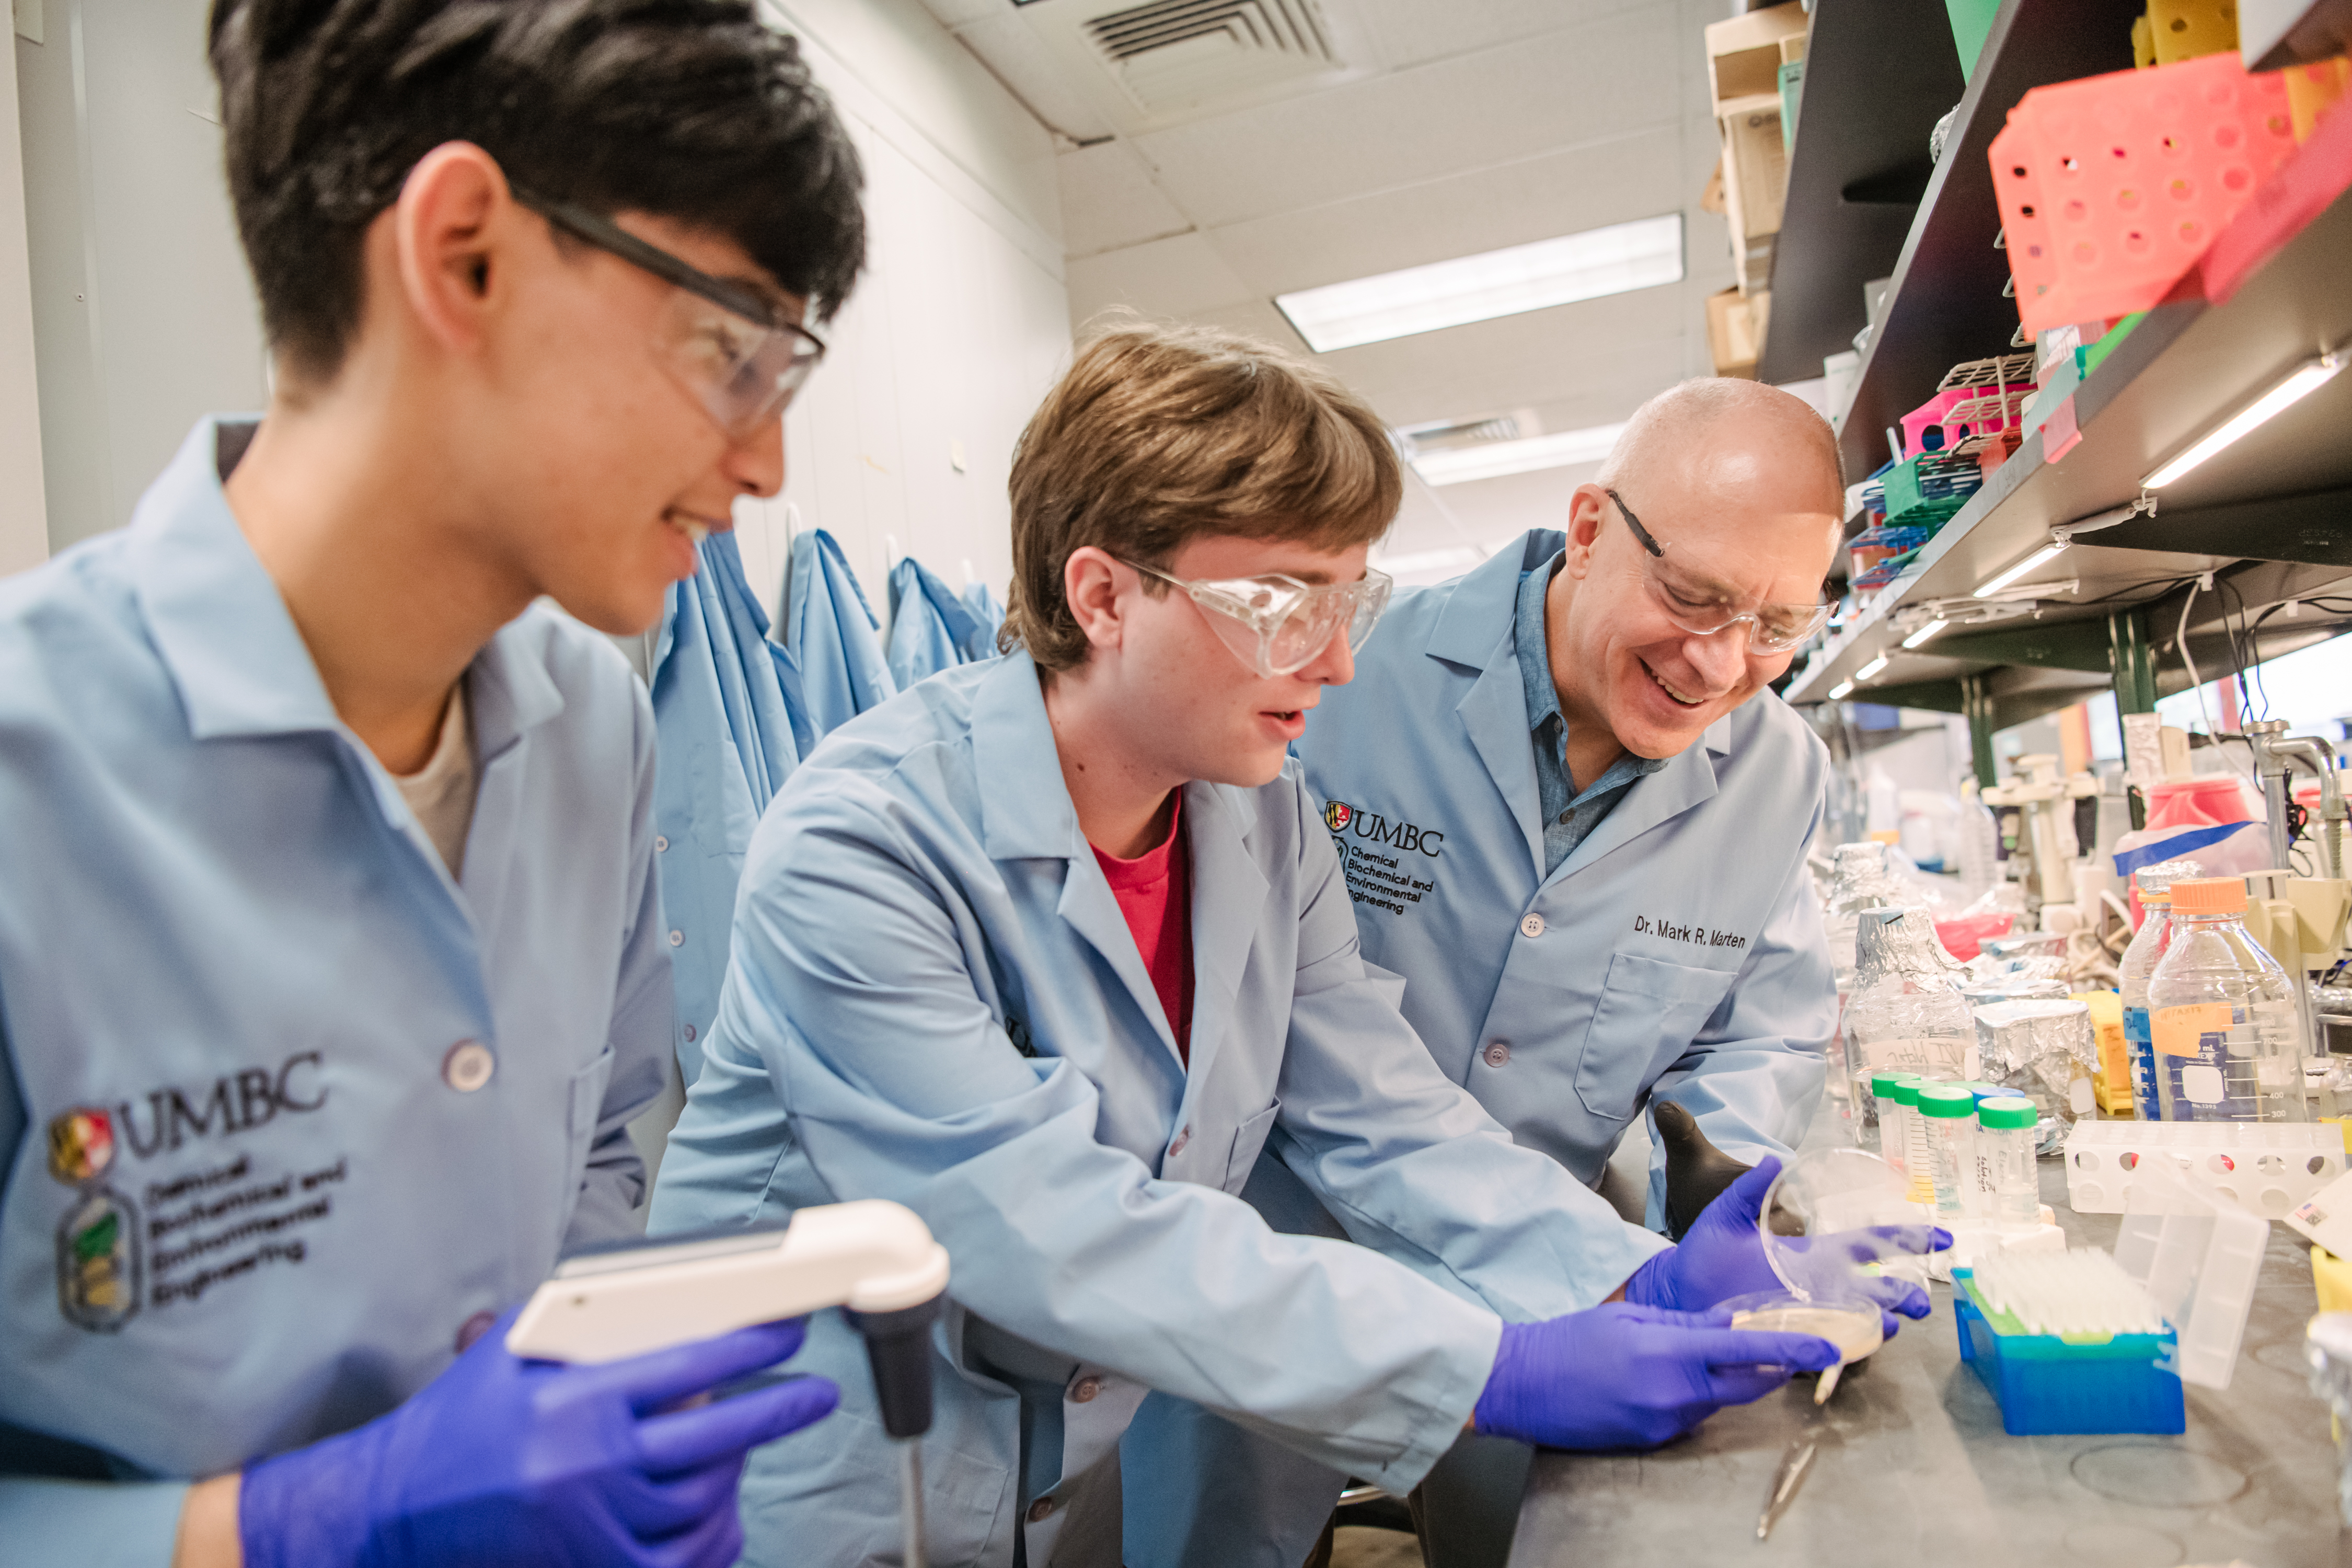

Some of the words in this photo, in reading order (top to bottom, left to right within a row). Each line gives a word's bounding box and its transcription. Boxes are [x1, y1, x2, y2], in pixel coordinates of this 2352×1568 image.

[1355, 810, 1444, 857] UMBC
[1351, 846, 1399, 869] Chemical
[1346, 871, 1422, 903] Environmental
[1348, 858, 1411, 885] Biochemical
[1412, 881, 1434, 892] and
[1634, 915, 1653, 935] Dr.
[1658, 919, 1691, 942] Mark
[1695, 927, 1706, 945] R.
[1710, 929, 1746, 949] Marten
[119, 1050, 329, 1159] UMBC
